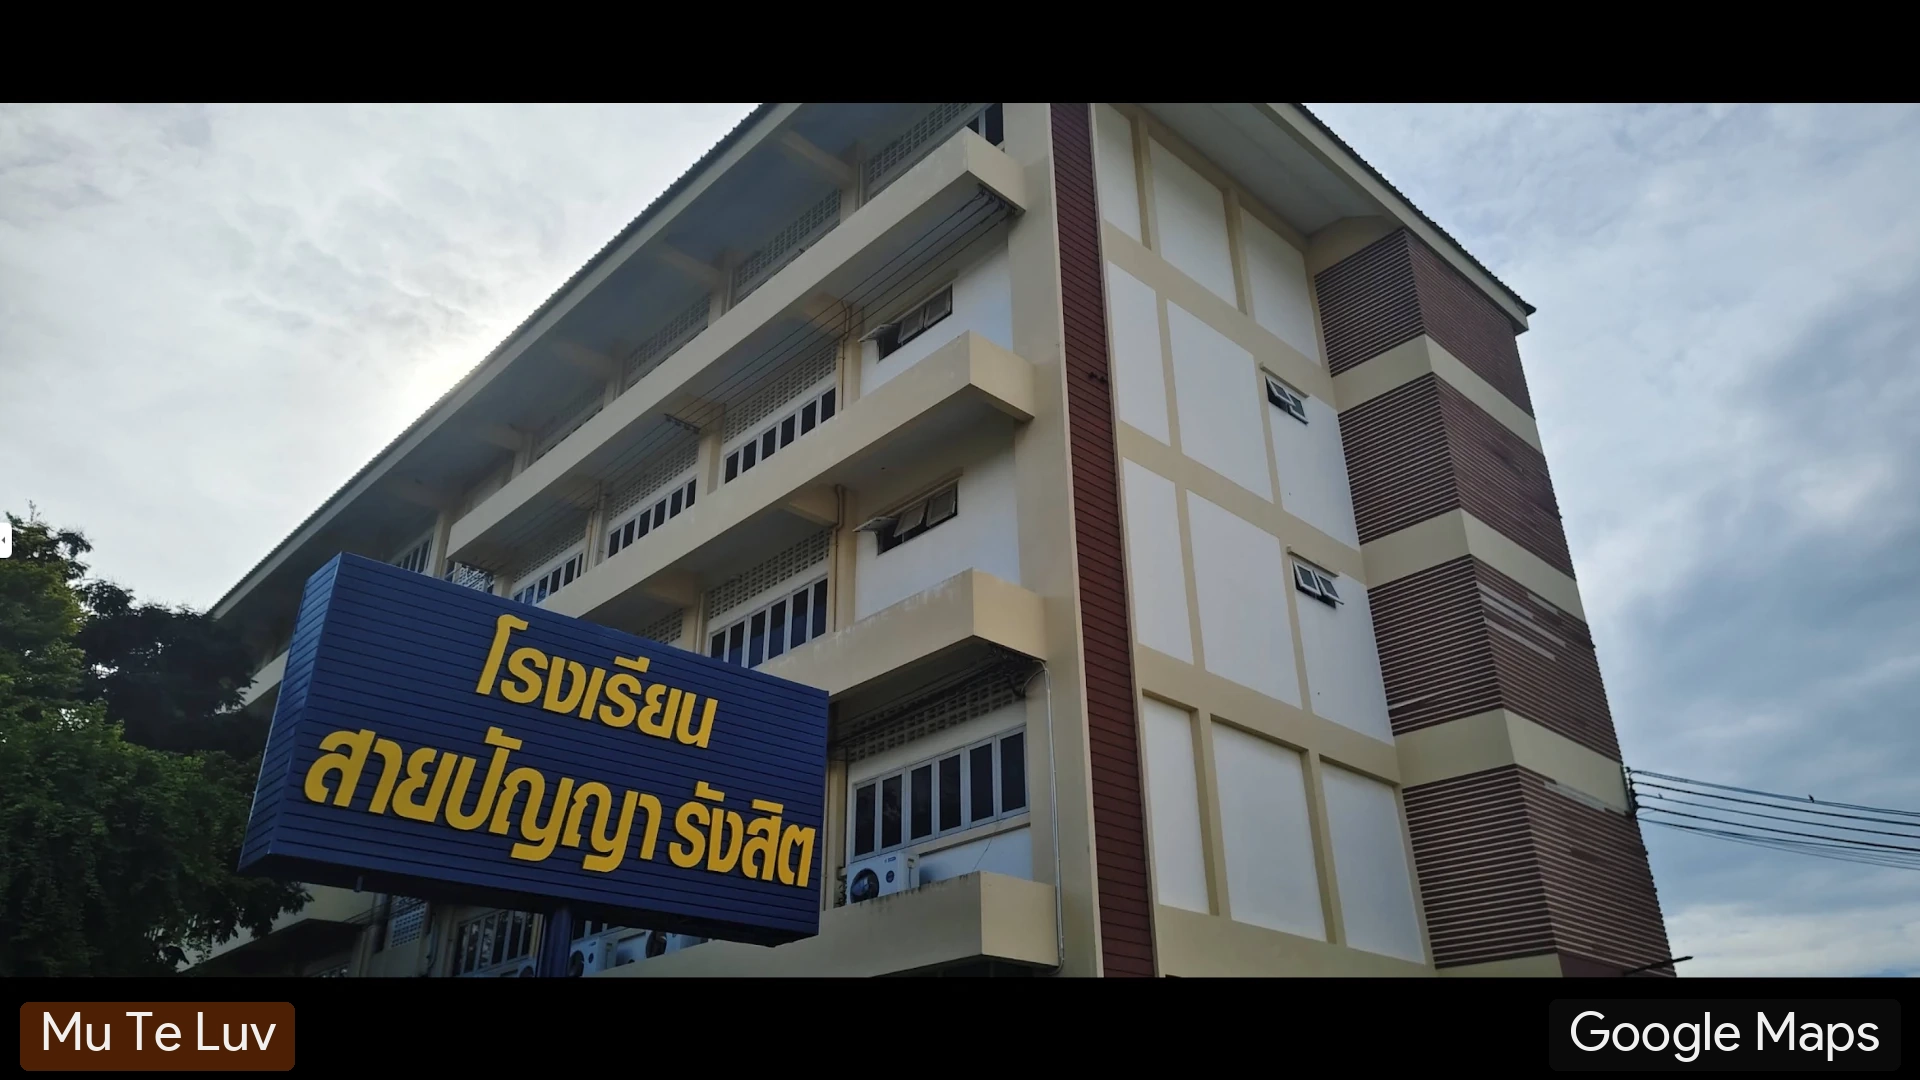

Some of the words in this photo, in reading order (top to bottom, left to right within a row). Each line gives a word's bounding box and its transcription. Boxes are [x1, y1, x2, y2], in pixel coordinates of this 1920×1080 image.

[476, 615, 718, 748] โรงเรียน
[304, 727, 662, 873] สายปัญญา
[669, 781, 816, 888] รังสิต
